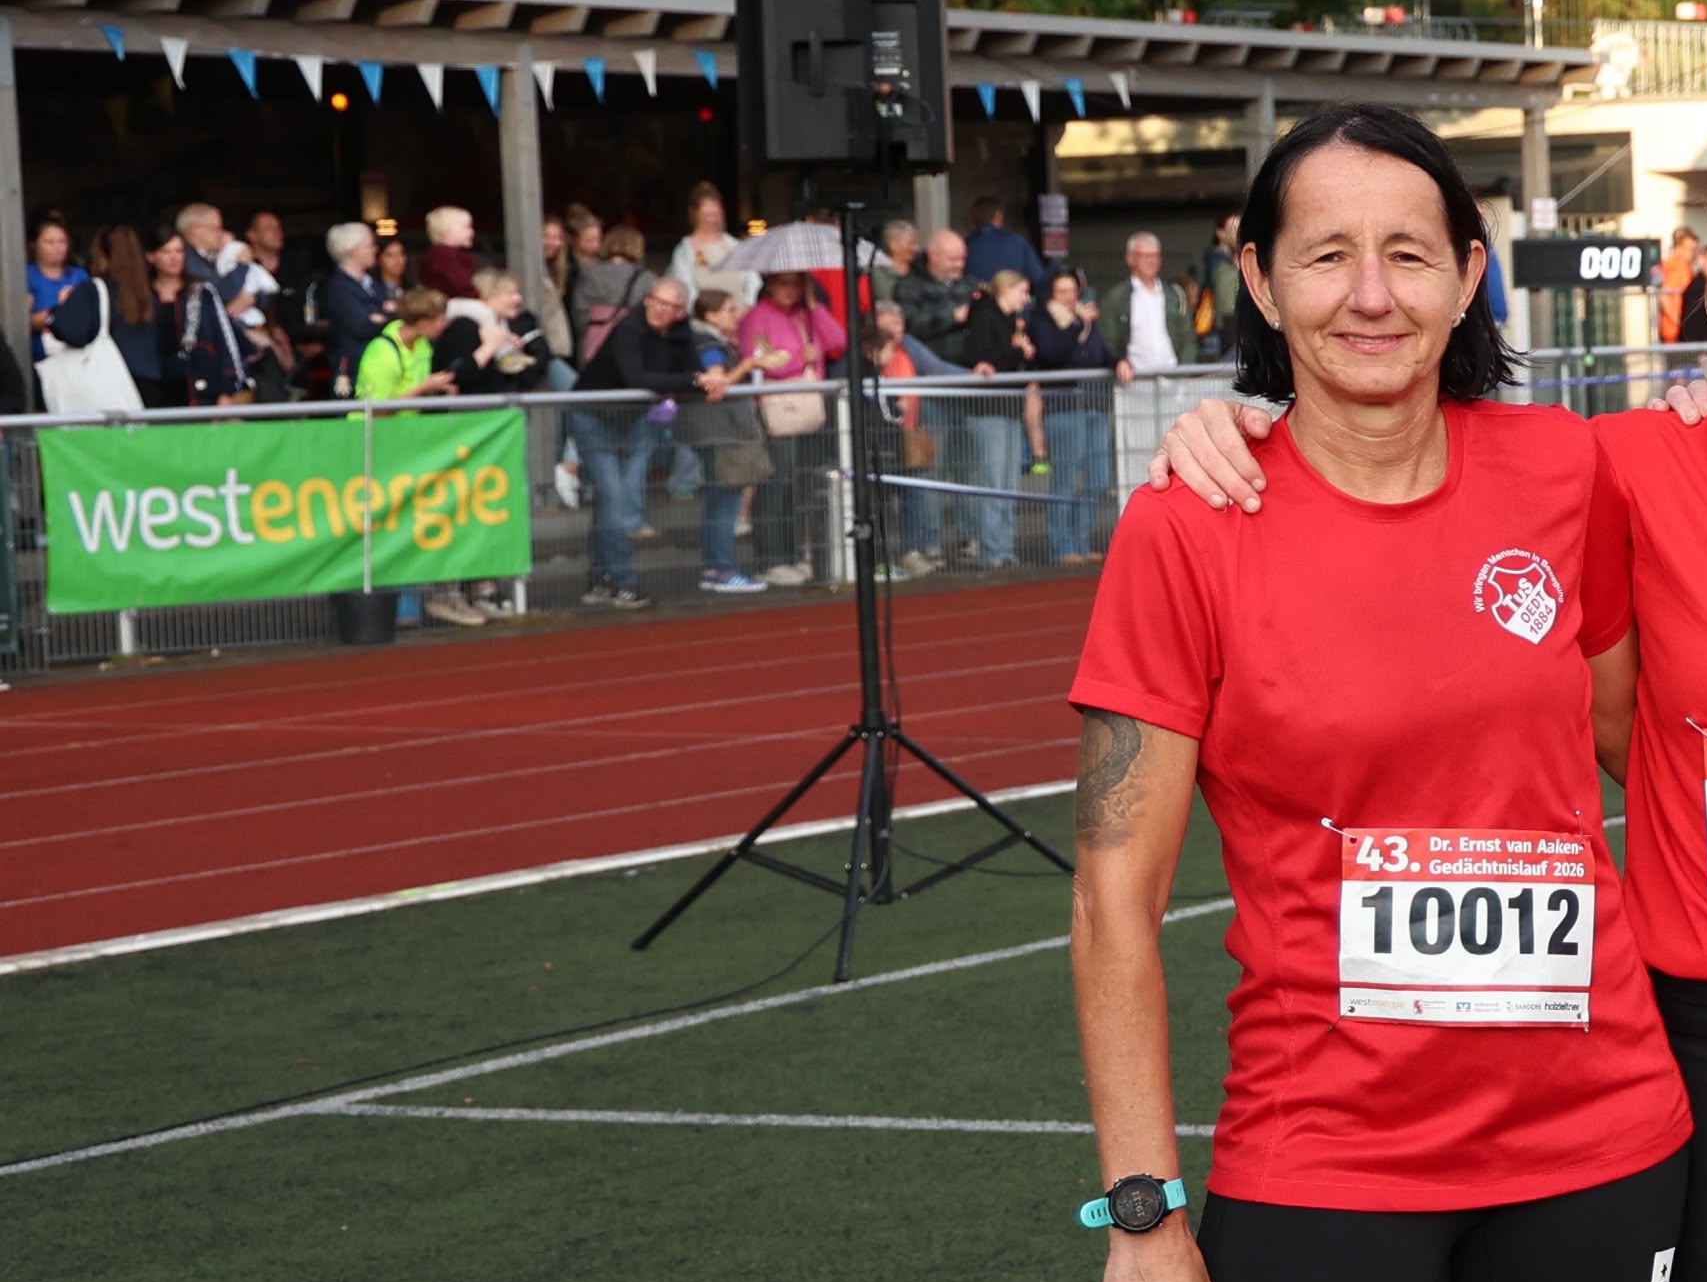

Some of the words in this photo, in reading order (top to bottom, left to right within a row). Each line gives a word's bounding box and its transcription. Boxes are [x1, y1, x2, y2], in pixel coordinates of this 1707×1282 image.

[68, 445, 510, 550] westenergie
[1487, 548, 1531, 565] Menschen
[1532, 553, 1540, 563] in
[1473, 563, 1491, 595] bringen
[1473, 596, 1485, 613] Wir
[1520, 591, 1545, 624] OEDT
[1530, 605, 1553, 635] 1884
[1356, 835, 1421, 873] 43.
[1429, 836, 1453, 852] Dr.
[1459, 836, 1502, 853] Ernst
[1506, 841, 1532, 853] van
[1536, 838, 1585, 855] Aaken-
[1429, 859, 1549, 877] Gedächtnislauf
[1552, 862, 1585, 877] 2026
[1361, 886, 1580, 956] 10012
